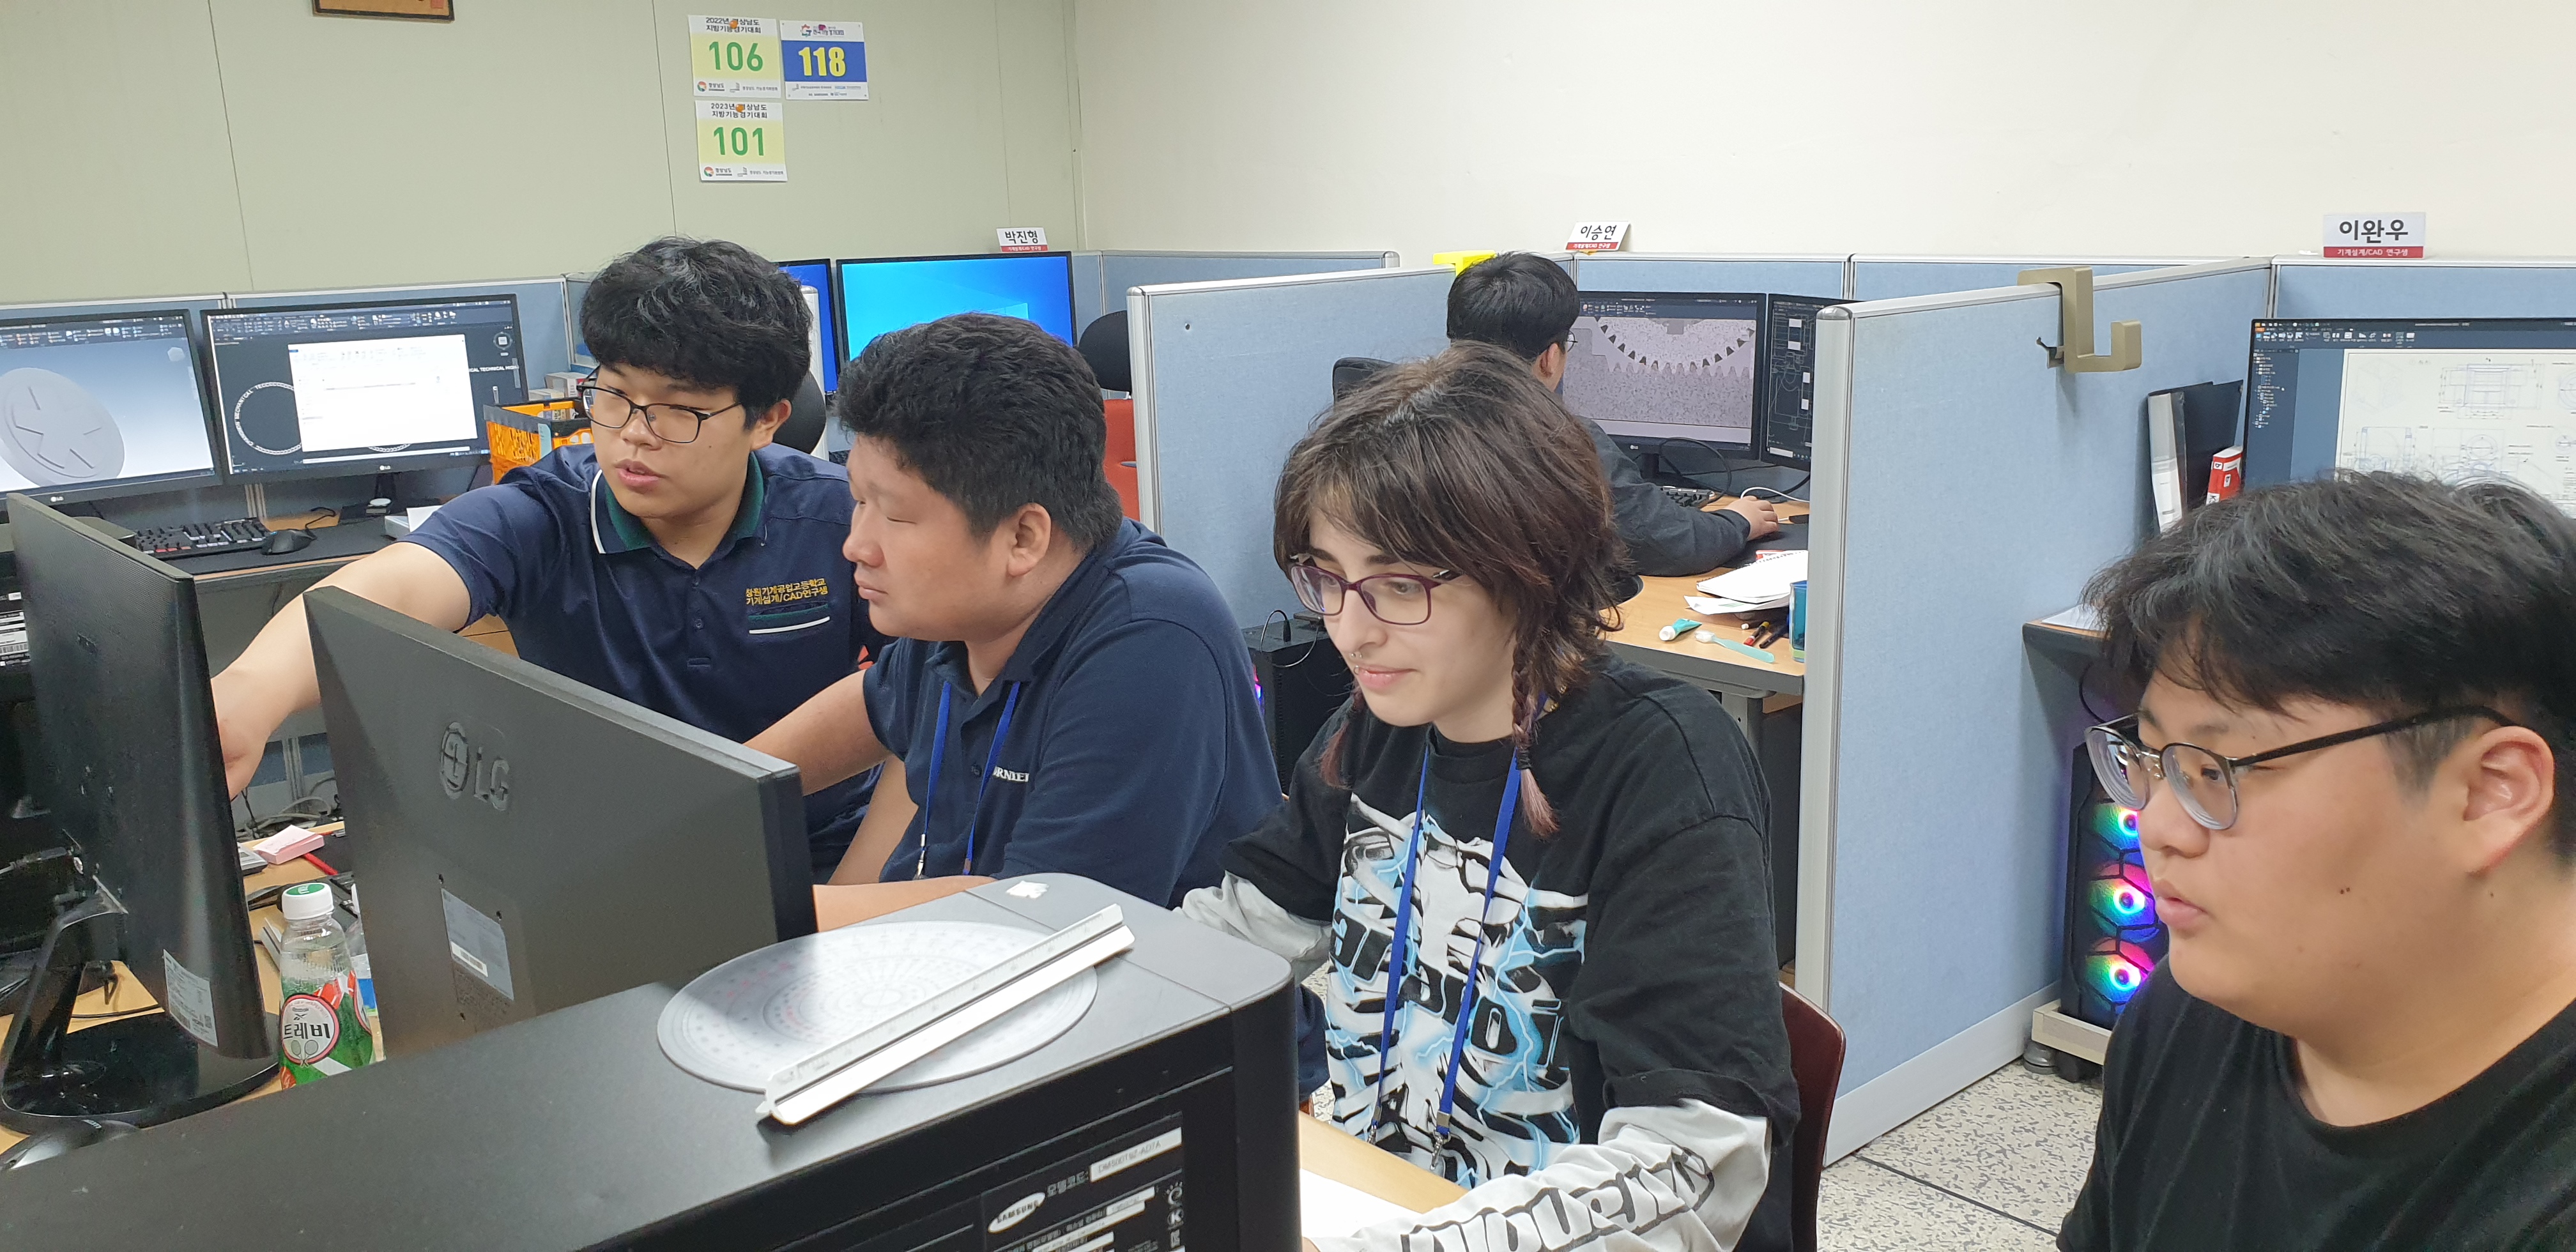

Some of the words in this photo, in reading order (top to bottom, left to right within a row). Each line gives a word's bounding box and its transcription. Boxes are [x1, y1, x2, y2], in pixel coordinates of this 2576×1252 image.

[709, 41, 763, 72] 106
[799, 47, 846, 77] 118
[714, 127, 764, 156] 101
[1004, 230, 1038, 244] 박진형
[1581, 225, 1617, 241] 이승연
[2339, 219, 2409, 243] 이완우
[473, 746, 510, 811] LG
[284, 1023, 330, 1039] 트레비
